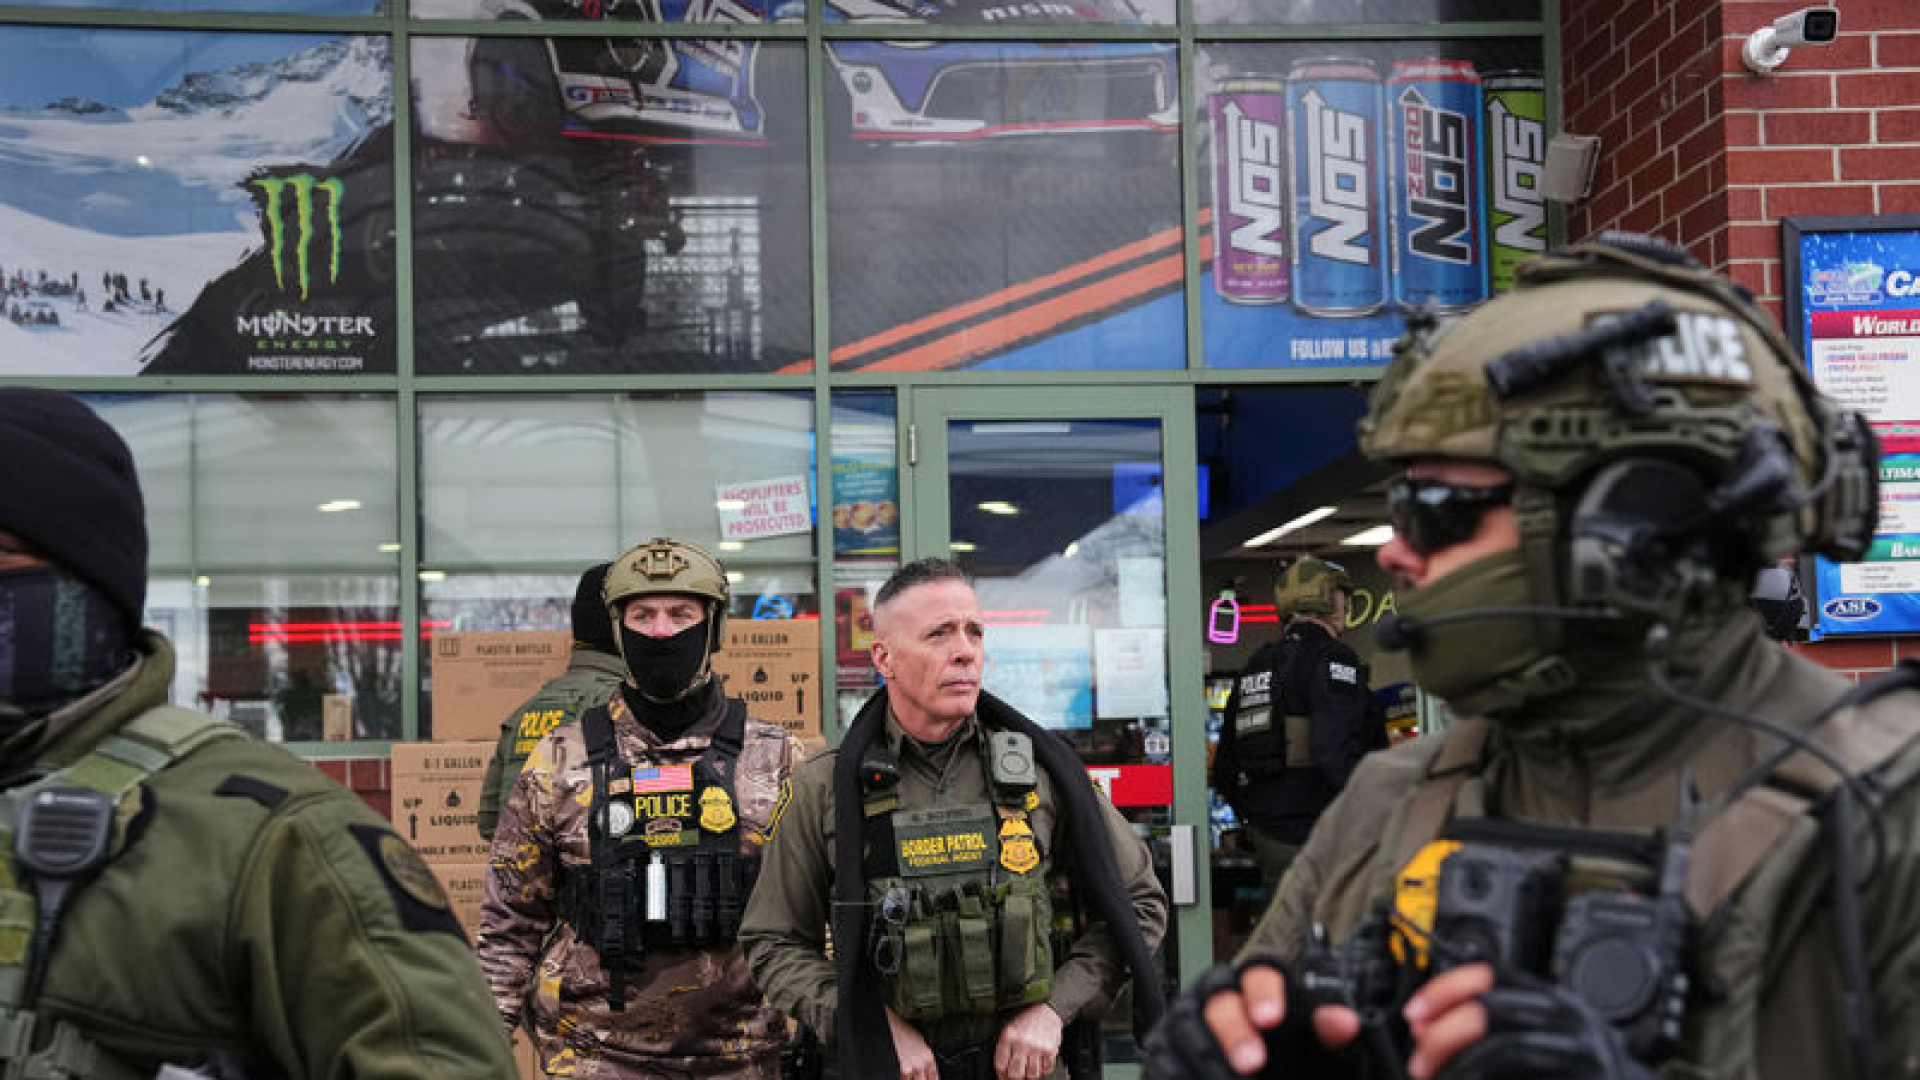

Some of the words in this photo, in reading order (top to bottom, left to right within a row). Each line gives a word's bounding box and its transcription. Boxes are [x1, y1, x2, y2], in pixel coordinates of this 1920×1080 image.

[1224, 101, 1283, 257] NOS
[1303, 89, 1370, 265] NOS
[1405, 105, 1423, 197] ZERO
[1405, 108, 1471, 265] NOS
[1488, 98, 1546, 251] NOS
[1290, 338, 1344, 360] FOLLOW
[635, 793, 692, 819] POLICE
[946, 831, 987, 853] PATROL
